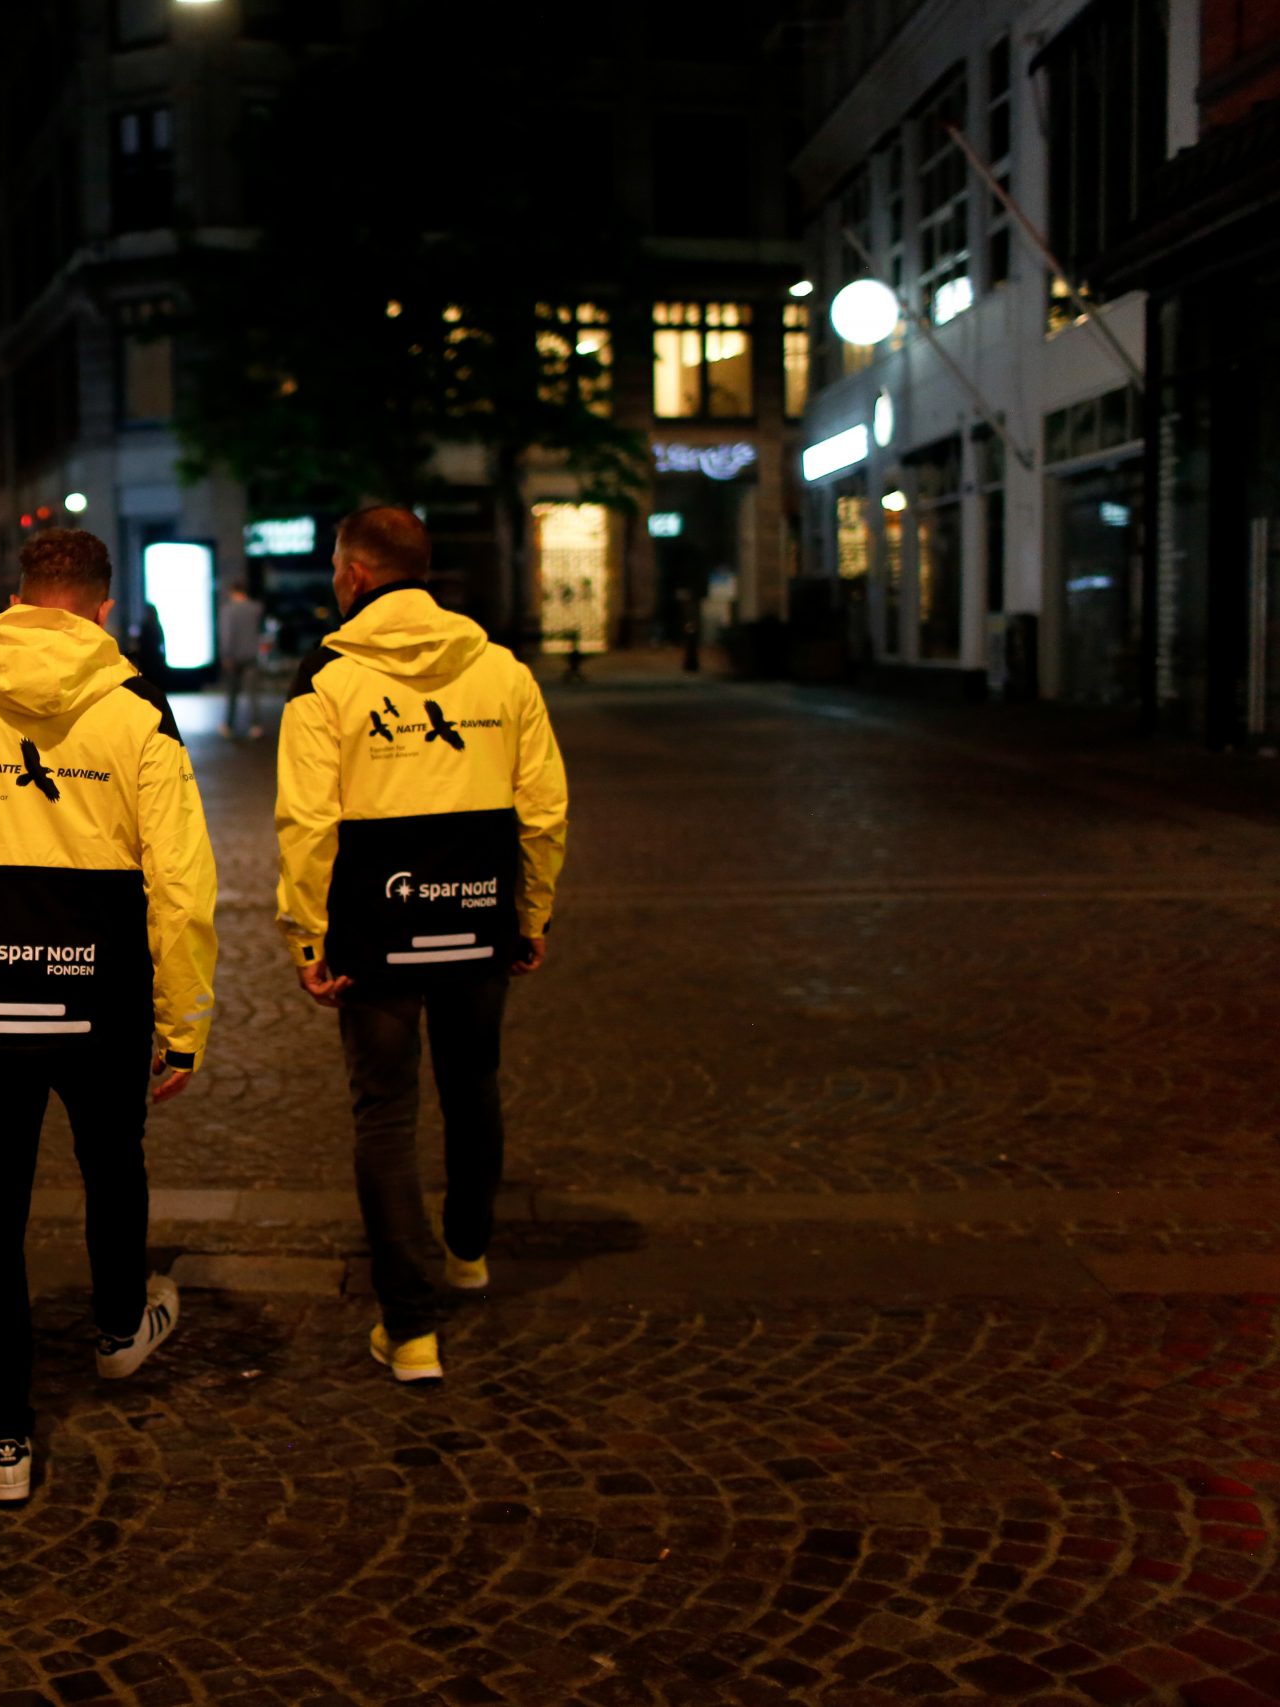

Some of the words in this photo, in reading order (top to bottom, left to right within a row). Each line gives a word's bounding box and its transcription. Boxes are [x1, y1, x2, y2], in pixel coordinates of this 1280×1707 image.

[396, 723, 427, 734] NATTE
[57, 768, 111, 782] RAVNENE
[419, 882, 460, 901] spar
[461, 897, 497, 909] FONDEN
[46, 965, 95, 976] FONDEN
